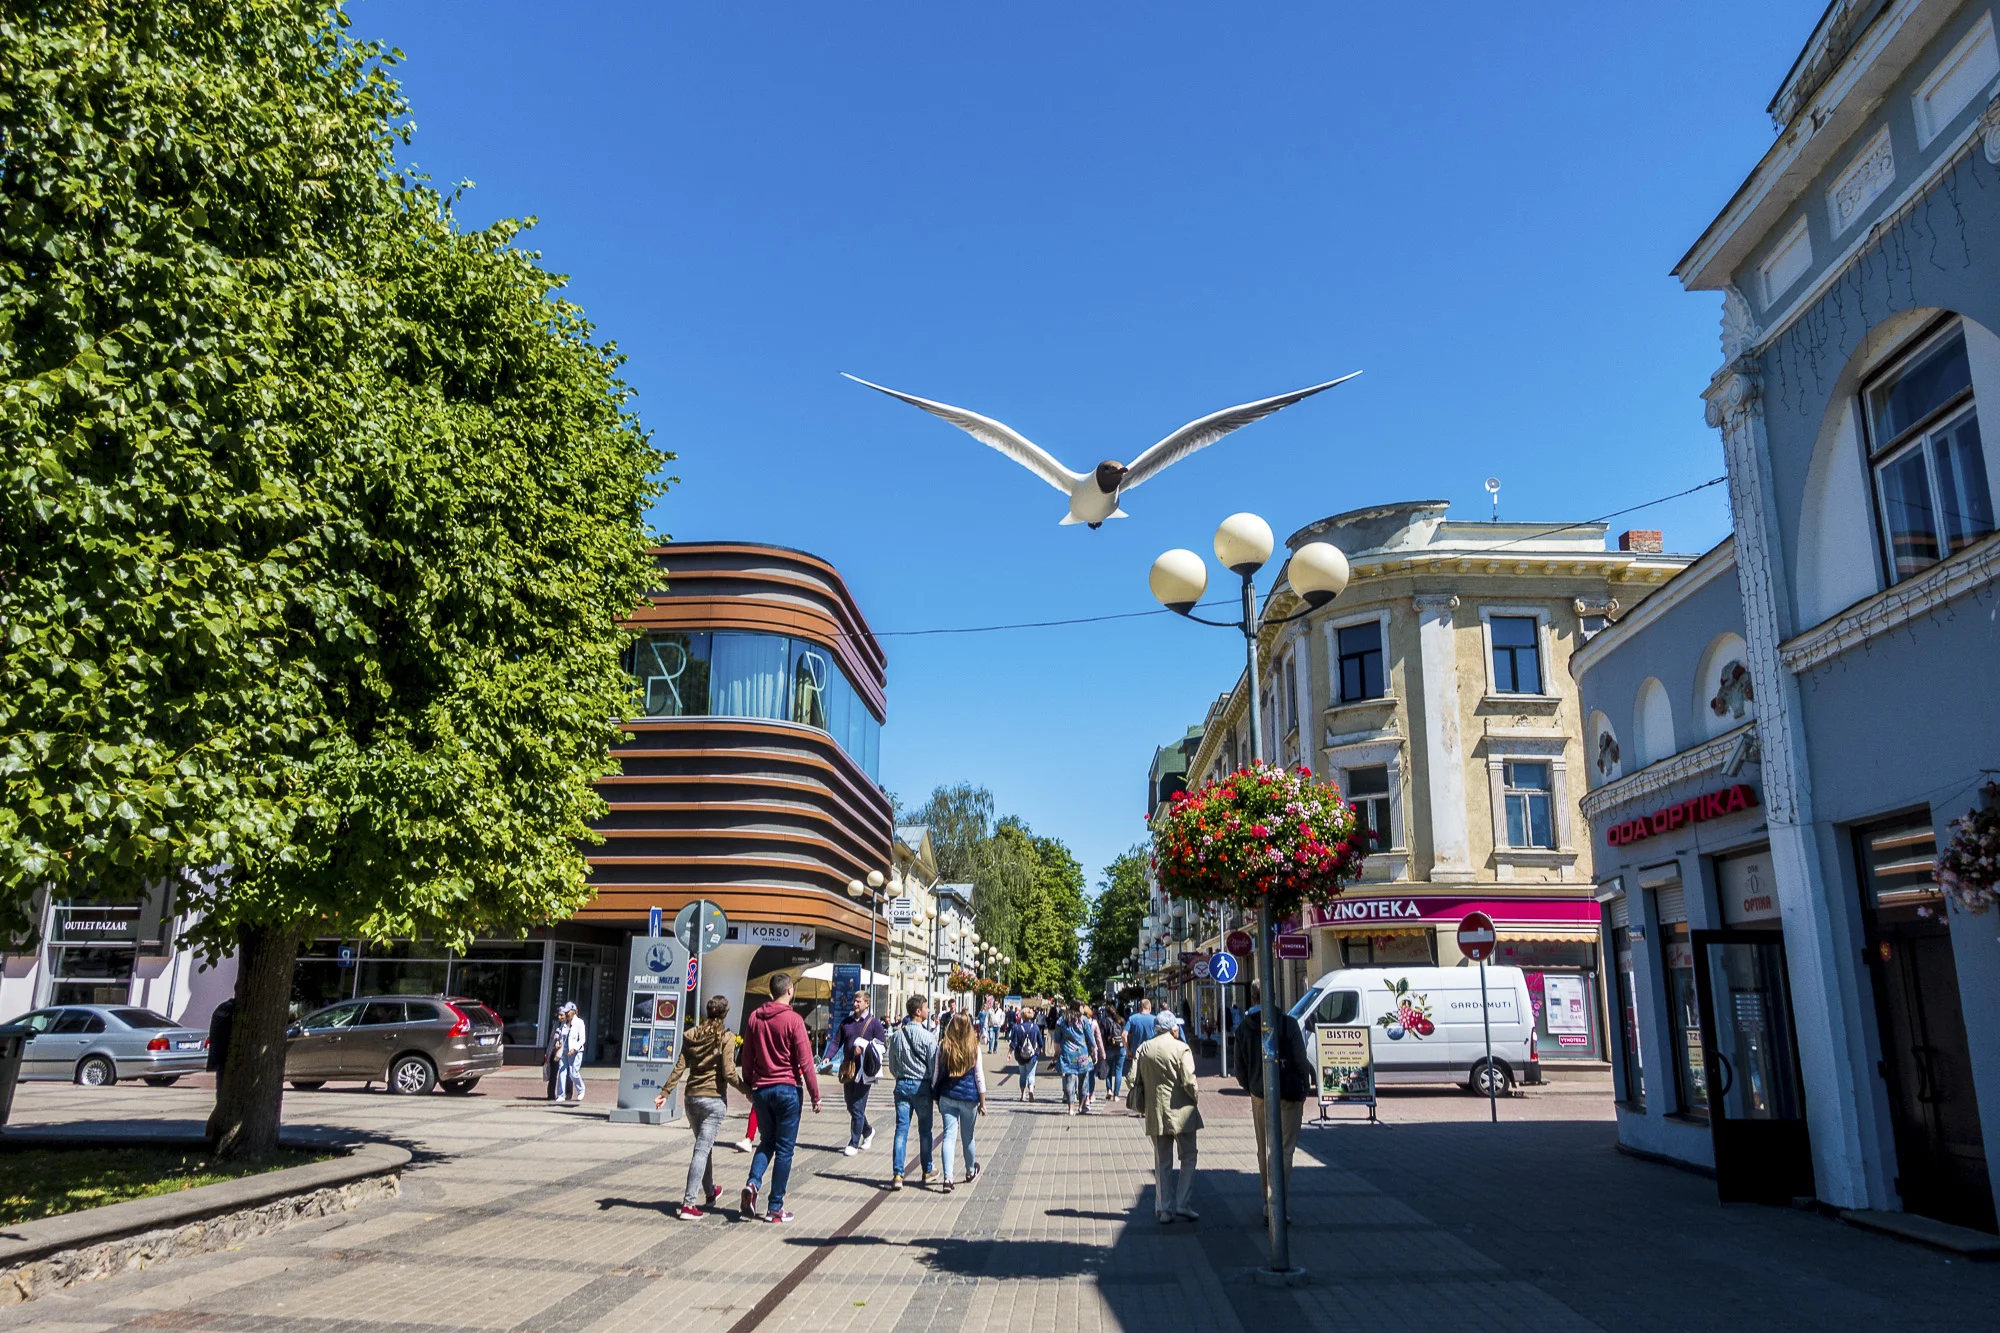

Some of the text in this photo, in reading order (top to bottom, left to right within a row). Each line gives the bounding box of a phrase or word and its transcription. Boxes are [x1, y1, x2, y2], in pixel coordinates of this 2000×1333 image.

[1607, 784, 1752, 847] ODA OPTIKA
[1743, 896, 1772, 912] OPTIKA
[65, 921, 127, 931] OUTLET BAZAAR
[752, 927, 790, 938] KORSO
[659, 976, 680, 985] MUZEJS
[1326, 1030, 1362, 1040] BISTRO
